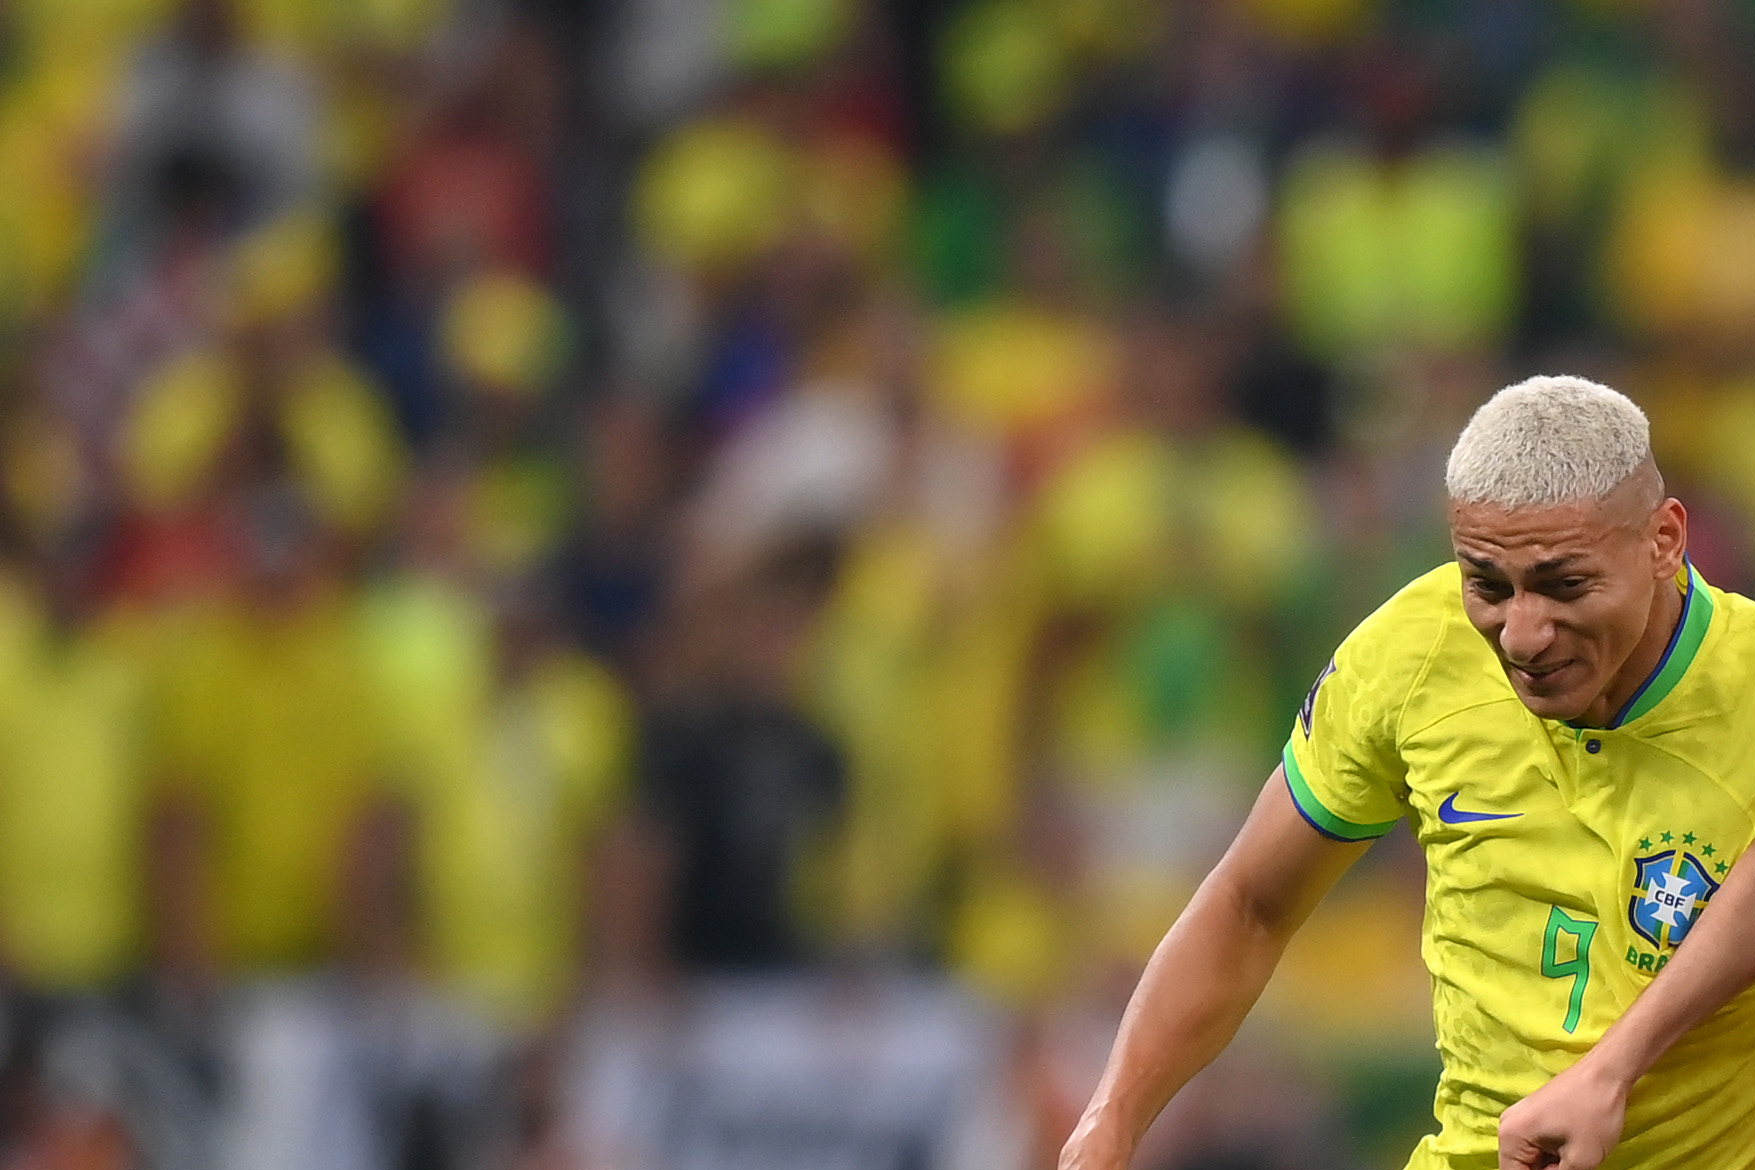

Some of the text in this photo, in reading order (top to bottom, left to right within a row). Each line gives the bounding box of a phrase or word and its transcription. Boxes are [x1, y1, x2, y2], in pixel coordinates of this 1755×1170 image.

[1655, 889, 1686, 909] CBF
[1540, 904, 1598, 1034] 9
[1626, 945, 1668, 972] BRA
